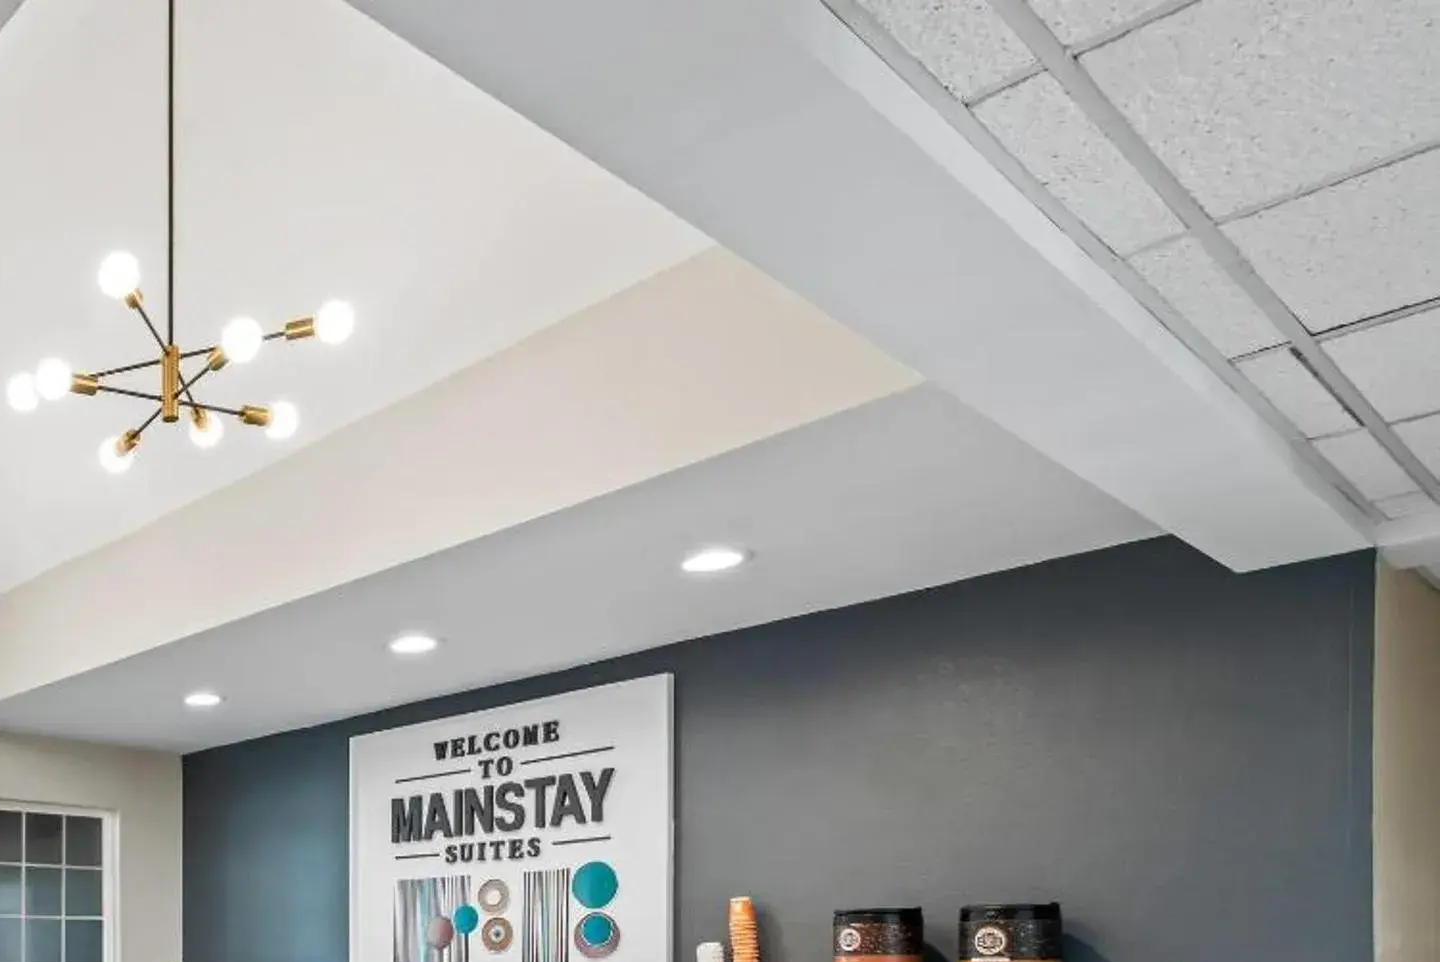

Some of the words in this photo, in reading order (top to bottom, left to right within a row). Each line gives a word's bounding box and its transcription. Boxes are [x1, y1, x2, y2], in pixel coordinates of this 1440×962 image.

[433, 720, 560, 761] WELCOME
[478, 756, 514, 779] TO
[391, 767, 616, 844] MAINSTAY
[445, 837, 542, 864] SUITES
